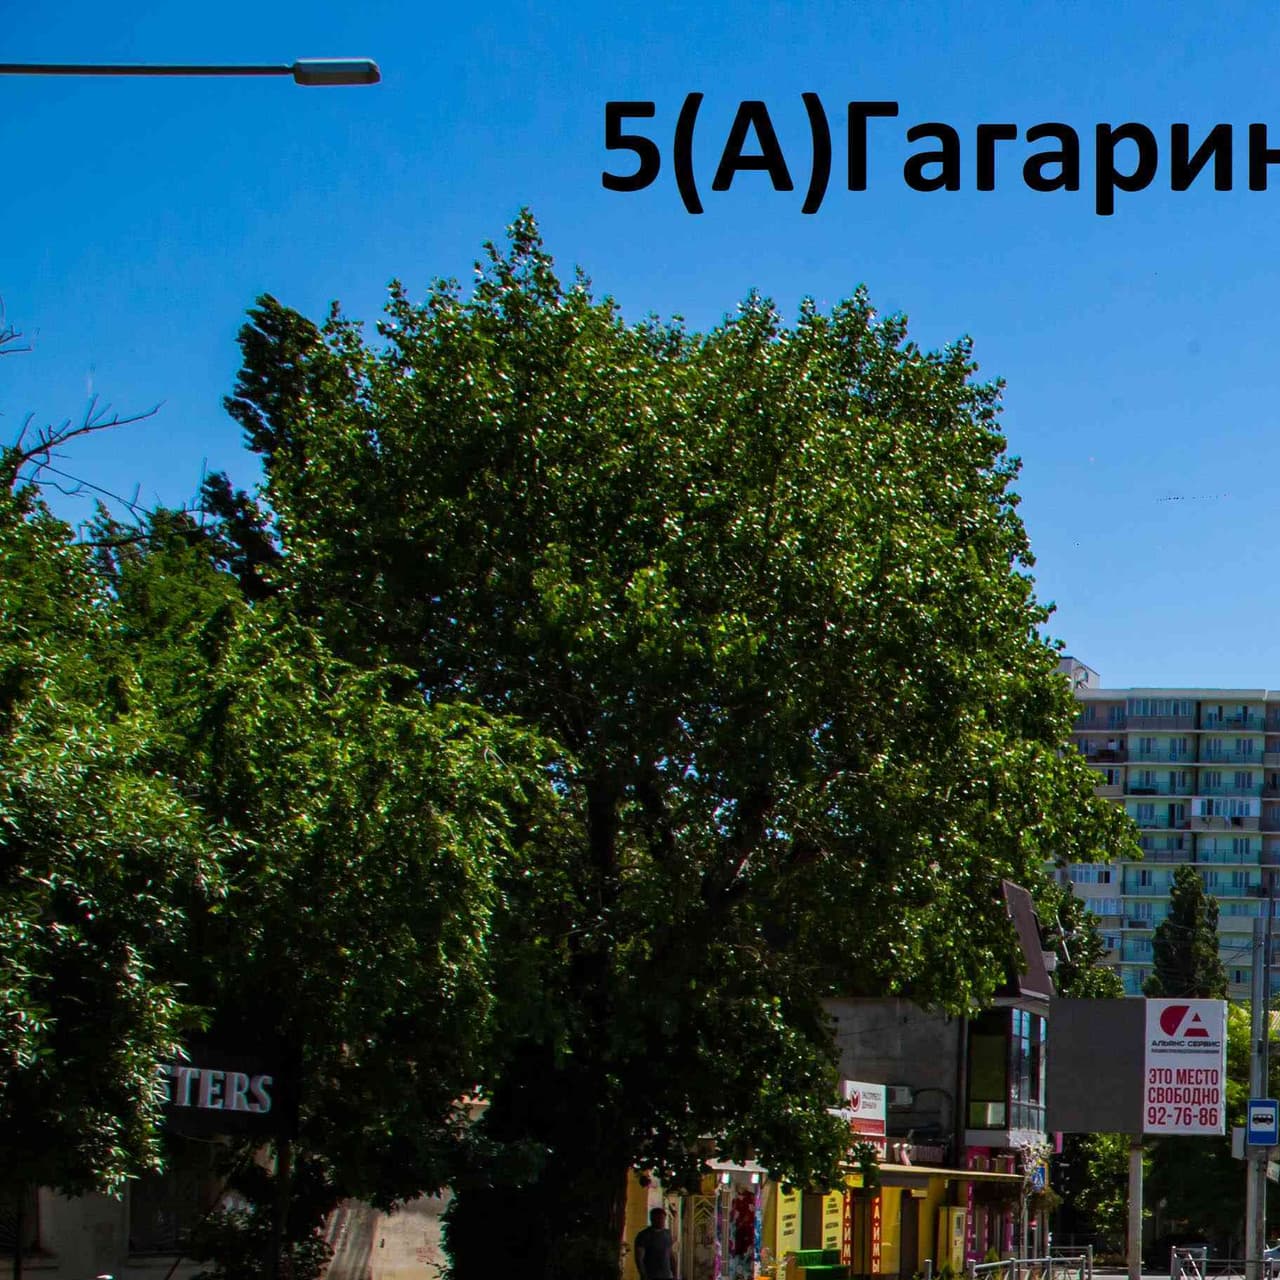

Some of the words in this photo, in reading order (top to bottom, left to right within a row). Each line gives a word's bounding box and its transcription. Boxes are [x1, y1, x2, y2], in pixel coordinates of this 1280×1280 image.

[1149, 1068, 1172, 1084] ЭТО
[1176, 1069, 1219, 1085] МЕСТО
[1148, 1087, 1219, 1106] СВОБОДНО
[1148, 1106, 1218, 1126] 92-76-86
